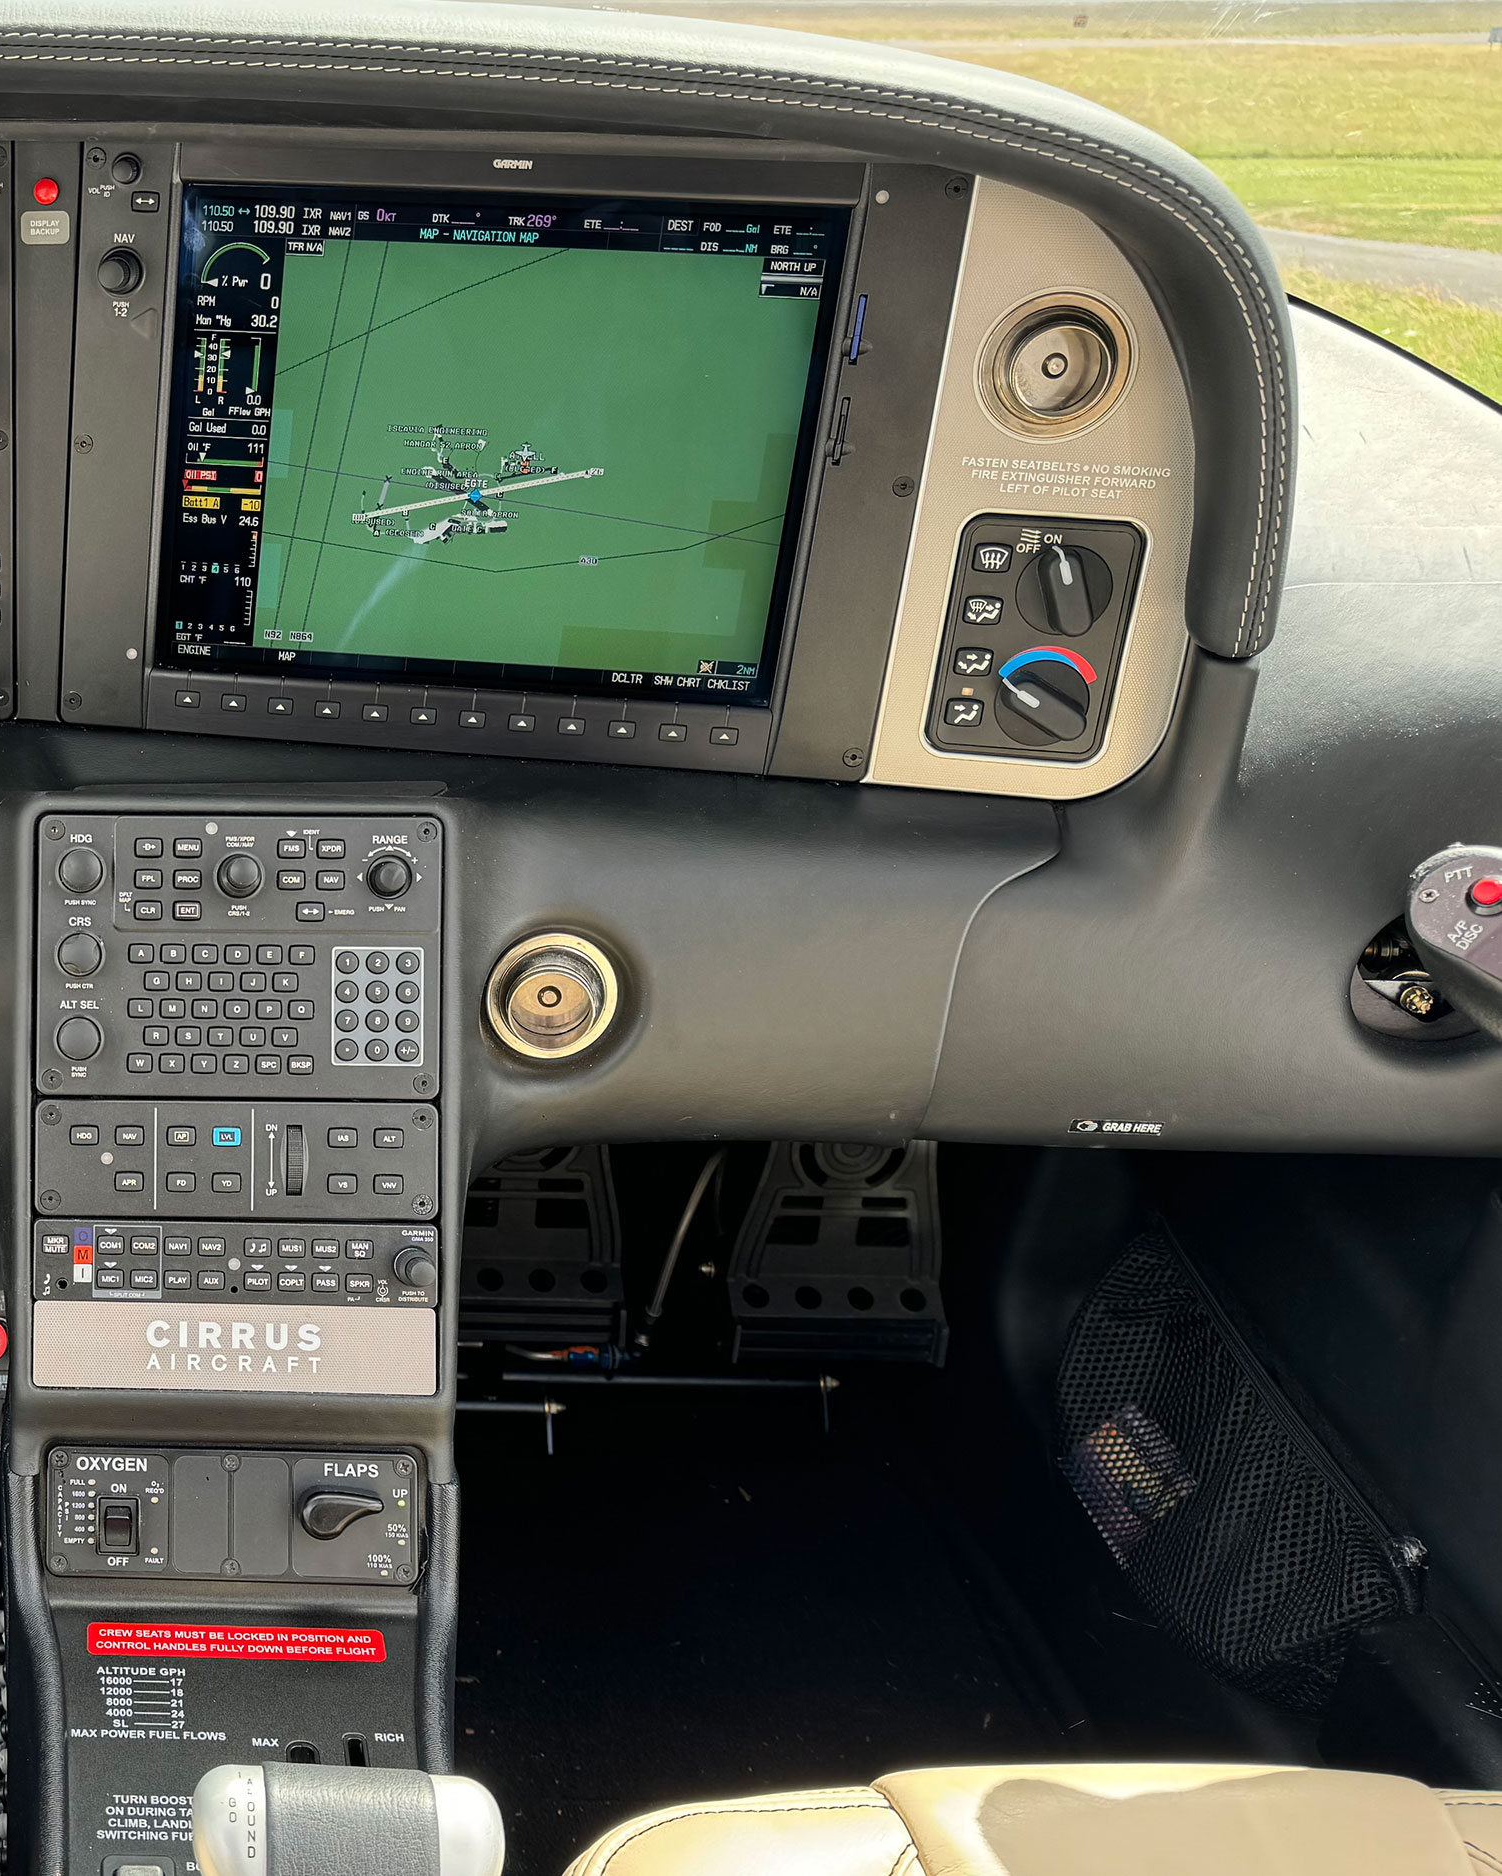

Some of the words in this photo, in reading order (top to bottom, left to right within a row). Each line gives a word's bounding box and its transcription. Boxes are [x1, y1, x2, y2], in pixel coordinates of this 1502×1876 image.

[493, 160, 532, 169] GARMIN
[203, 206, 234, 216] 110.50
[254, 205, 295, 218] 109.90
[303, 208, 322, 219] IXR
[330, 211, 351, 221] NAV1
[202, 221, 233, 232] 110.50
[254, 221, 294, 234] 109.90
[302, 225, 320, 236] IXR
[328, 227, 351, 236] NAV2
[114, 234, 135, 243] NAV
[420, 229, 439, 239] MAP
[453, 230, 516, 242] NAVIGATION
[520, 232, 539, 243] MAP
[251, 315, 278, 328] 30.2
[962, 457, 1008, 468] FASTEN
[1011, 460, 1080, 472] SEATBELTS
[1092, 464, 1110, 474] NO
[1113, 466, 1170, 478] SMOKING
[971, 469, 998, 479] FIRE
[1001, 472, 1090, 485] EXTINGUISHER
[1094, 477, 1156, 489] FORWARD
[1000, 483, 1030, 493] LEFT
[1032, 485, 1049, 495] OF
[1052, 486, 1088, 497] PILOT
[1090, 489, 1122, 499] SEAT
[1044, 534, 1062, 544] ON
[1016, 544, 1041, 554] OFF
[178, 645, 211, 655] ENGINE
[279, 652, 296, 661] MAP
[612, 673, 642, 684] DCLTR
[654, 675, 673, 686] SHW
[677, 677, 701, 688] CHRT
[707, 679, 750, 691] CHKLIST
[70, 834, 92, 843] HDG
[372, 835, 407, 845] RANGE
[1444, 866, 1473, 883] PTT
[69, 917, 91, 927] CRS
[1456, 924, 1483, 950] DISC
[60, 1000, 78, 1010] ALT
[80, 1000, 99, 1010] SEL
[266, 1124, 278, 1132] DN
[1102, 1122, 1132, 1132] GRAB
[1133, 1123, 1162, 1133] HERE
[100, 1241, 122, 1249] COM1
[133, 1242, 155, 1250] COM2
[168, 1243, 187, 1251] NAV1
[202, 1244, 222, 1252] NAV2
[146, 1320, 321, 1350] CIRRUS
[146, 1354, 321, 1373] AIRCRAFT
[76, 1457, 147, 1472] OXYGEN
[324, 1463, 379, 1478] FLAPS
[111, 1484, 126, 1493] ON
[393, 1489, 408, 1498] UP
[387, 1524, 406, 1533] 50%
[107, 1557, 129, 1567] OFF
[367, 1554, 391, 1563] 100%
[99, 1629, 132, 1637] CREW
[136, 1630, 171, 1638] SEATS
[175, 1631, 206, 1639] MUST
[227, 1632, 274, 1641] LOCKED
[277, 1633, 288, 1642] IN
[291, 1633, 344, 1643] POSITION
[347, 1635, 371, 1643] AND
[96, 1641, 150, 1650] CONTROL
[153, 1642, 207, 1652] HANDLES
[210, 1644, 245, 1652] FULLY
[248, 1645, 283, 1653] DOWN
[286, 1646, 332, 1655] BEFORE
[336, 1647, 376, 1656] FLIGHT
[96, 1667, 156, 1675] ALTITUDE
[160, 1668, 186, 1676] GPH
[100, 1677, 132, 1685] 16000
[170, 1678, 183, 1686] 17
[100, 1688, 132, 1696] 12000
[170, 1689, 183, 1697] 18
[106, 1698, 132, 1706] 8000
[170, 1699, 183, 1707] 21
[106, 1709, 133, 1717] 4000
[171, 1710, 185, 1718] 24
[113, 1720, 128, 1728] SL
[171, 1721, 184, 1729] 27
[71, 1729, 97, 1738] MAX
[101, 1730, 145, 1739] POWER
[149, 1731, 180, 1739] FUEL
[183, 1732, 226, 1740] FLOWS
[375, 1733, 404, 1742] RICH
[113, 1795, 147, 1804] TURN
[151, 1796, 193, 1805] BOOST
[106, 1807, 124, 1815] ON
[128, 1808, 176, 1816] DURING
[108, 1819, 151, 1829] CLIMB,
[97, 1830, 168, 1840] SWITCHING
